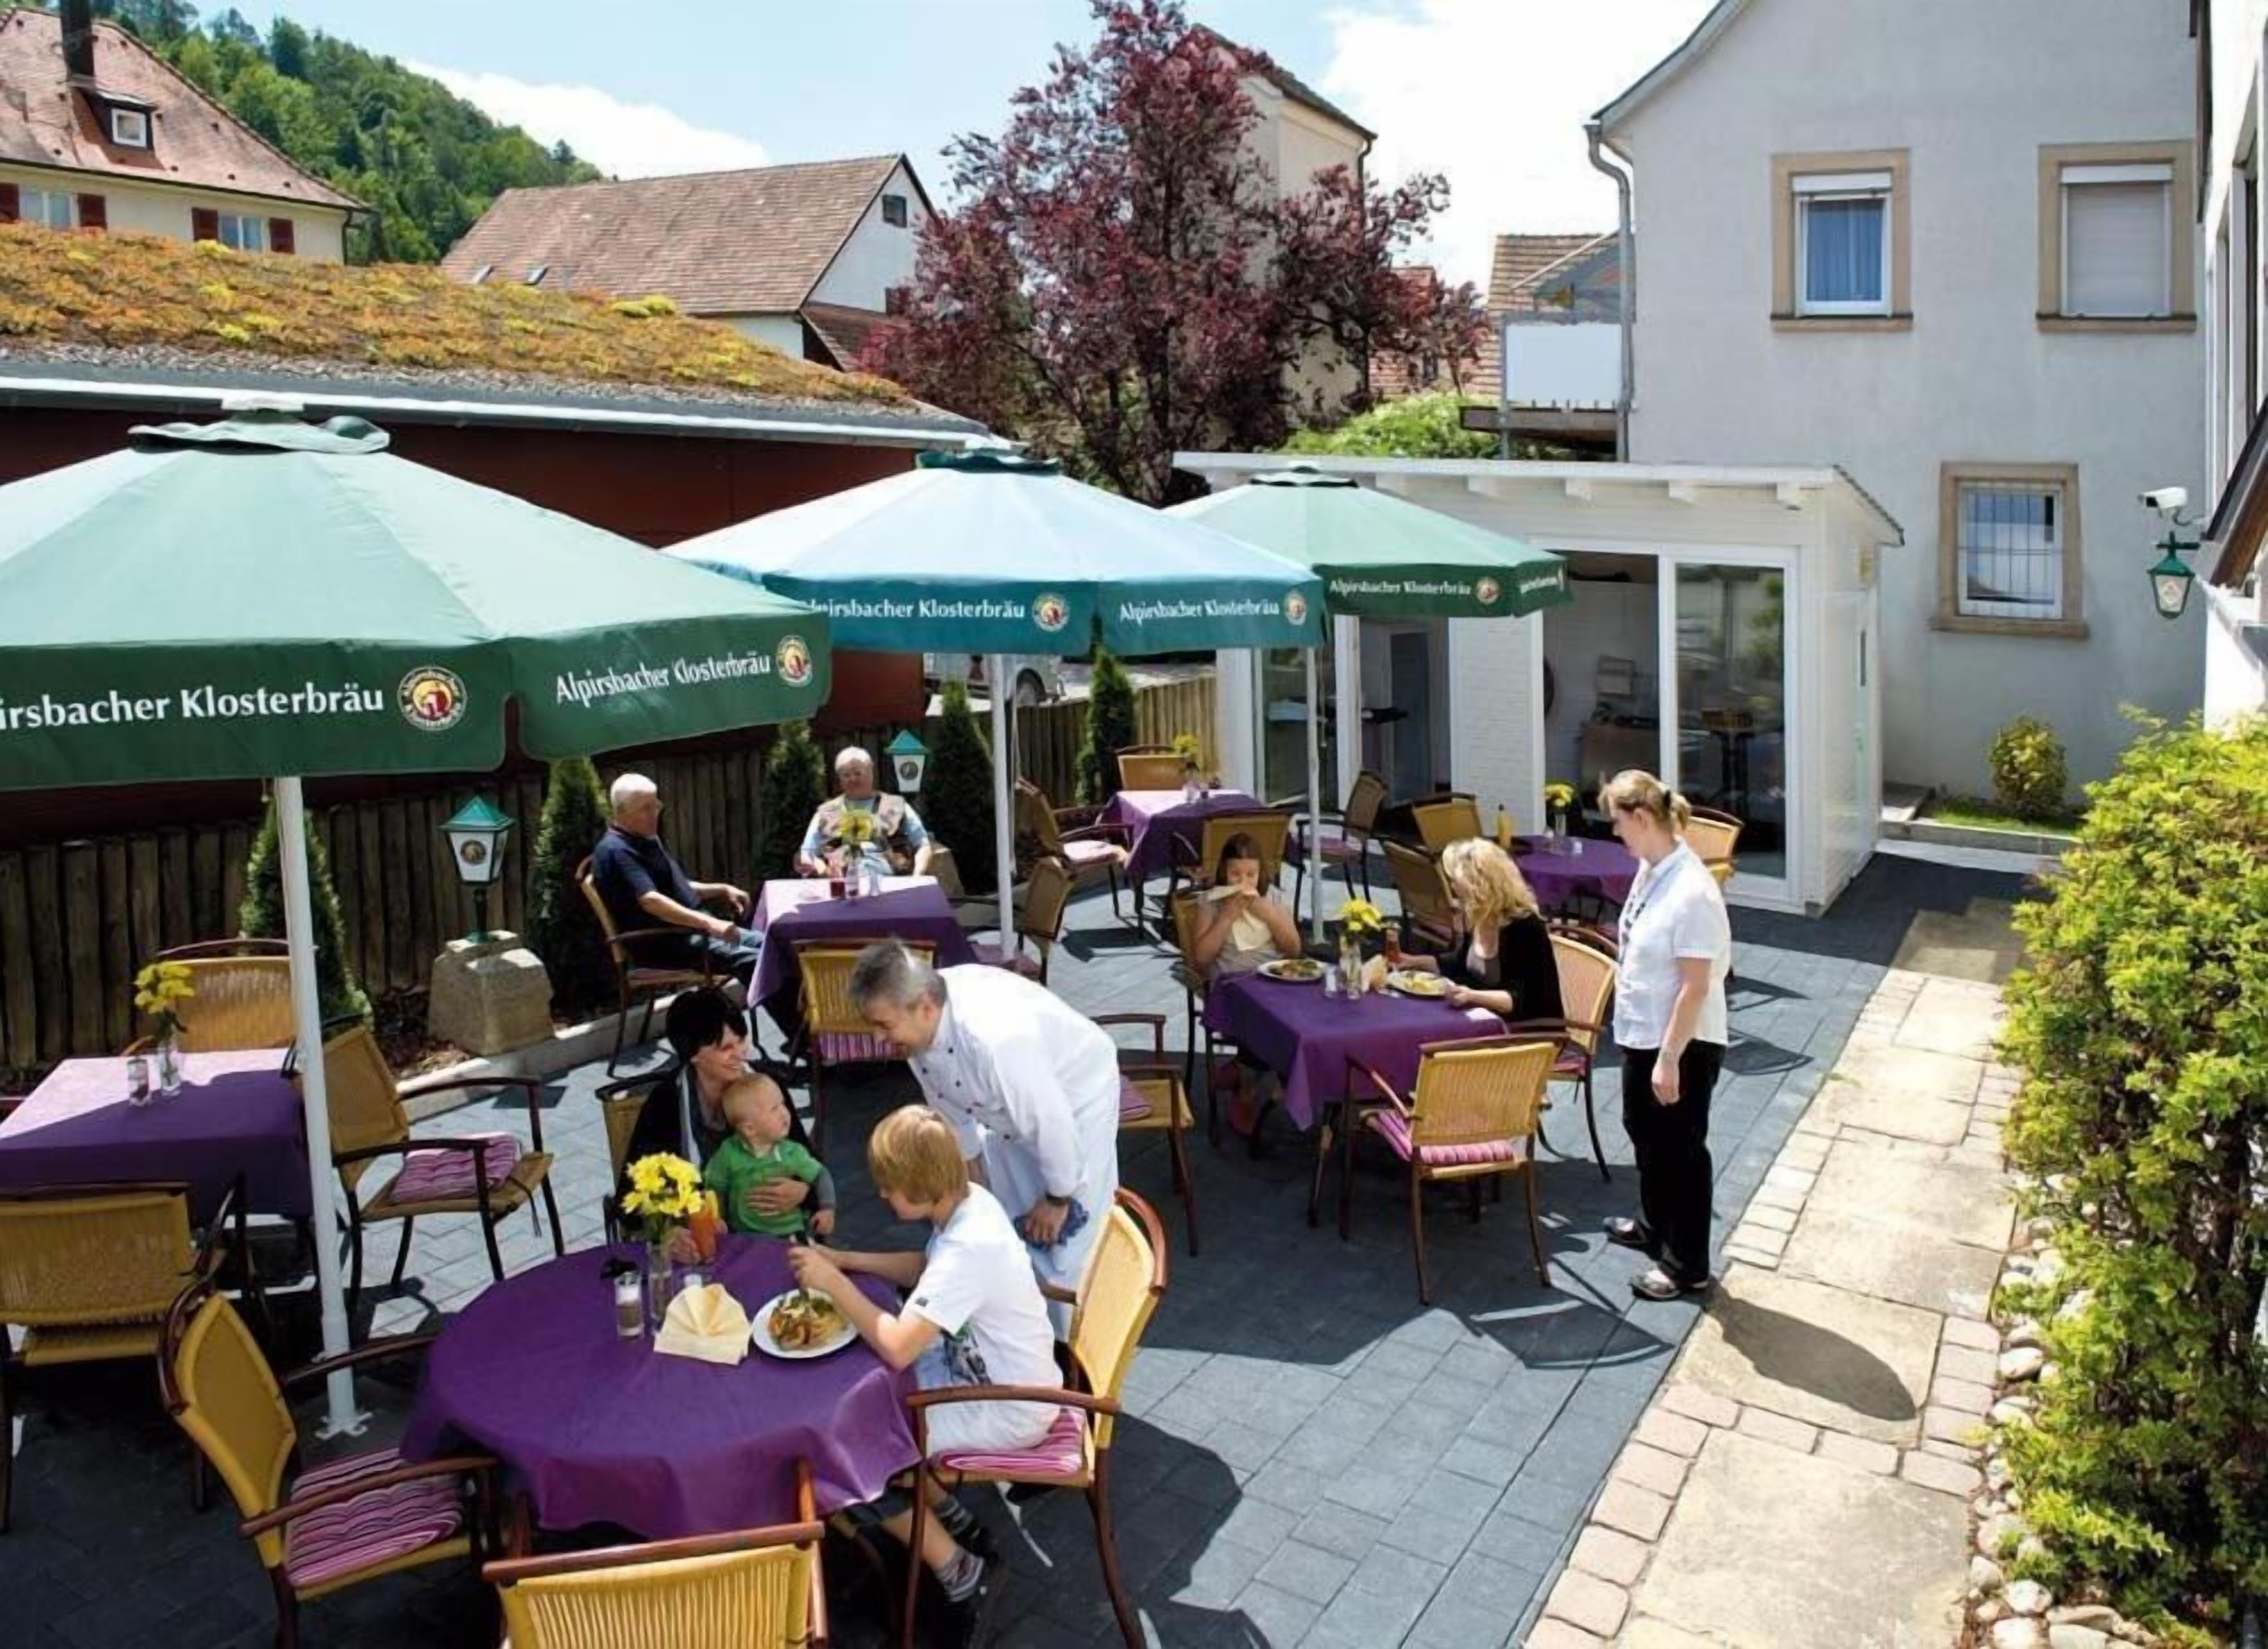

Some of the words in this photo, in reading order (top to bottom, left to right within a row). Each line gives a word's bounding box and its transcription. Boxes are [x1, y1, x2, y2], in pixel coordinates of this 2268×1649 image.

[805, 598, 913, 618] irsbacher
[919, 599, 1025, 618] Klosterbräu
[1120, 600, 1202, 626] Alpirsbacher
[1204, 599, 1279, 617] Klosterbräu
[556, 662, 669, 707] Alpirsbacher
[673, 652, 771, 684] Klosterbräu
[181, 682, 383, 717] Klosterbräu
